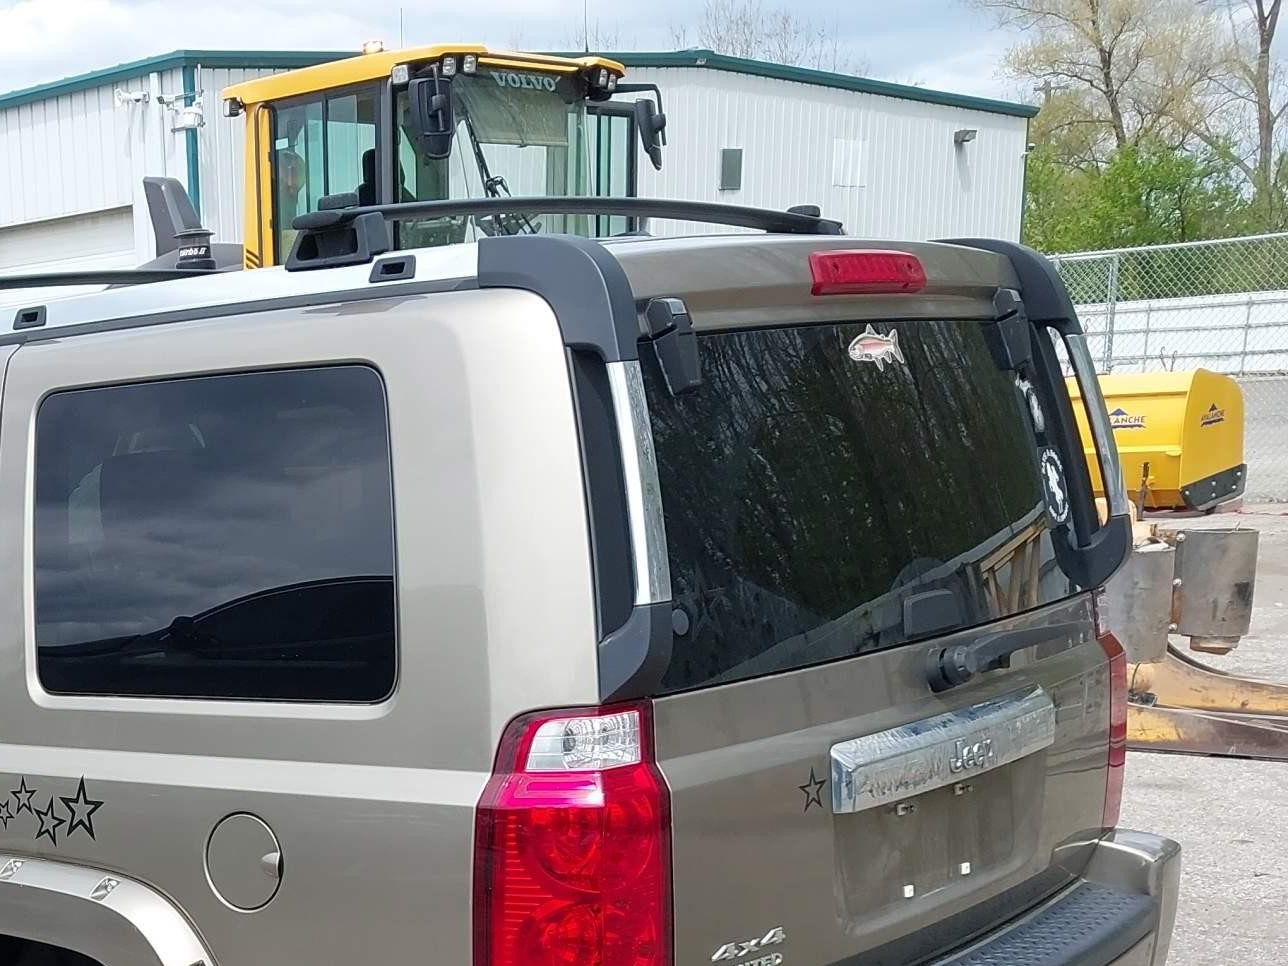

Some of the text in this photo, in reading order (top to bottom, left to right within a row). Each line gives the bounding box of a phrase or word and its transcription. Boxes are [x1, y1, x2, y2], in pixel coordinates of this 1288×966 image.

[489, 71, 556, 92] VOLVO
[949, 737, 993, 773] Jeep
[711, 925, 786, 962] 4x4
